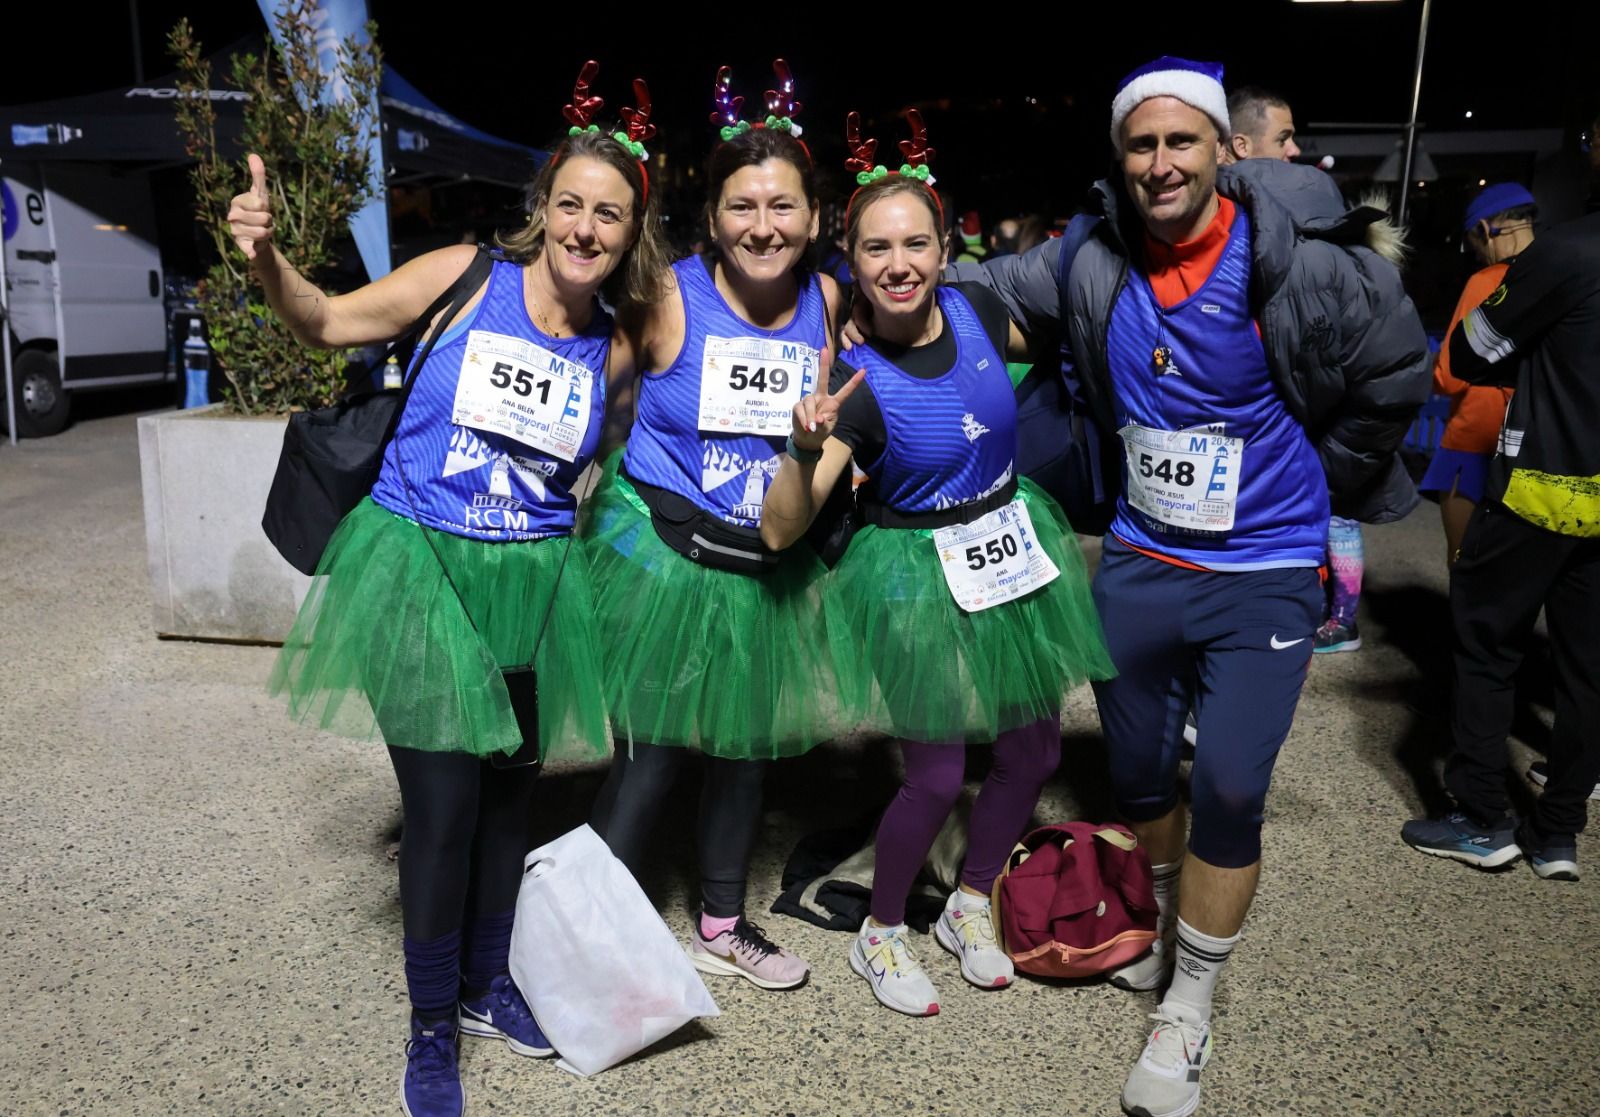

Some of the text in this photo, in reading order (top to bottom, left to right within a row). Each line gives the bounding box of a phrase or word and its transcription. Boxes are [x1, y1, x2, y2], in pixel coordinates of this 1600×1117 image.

[490, 361, 552, 405] 551
[729, 364, 789, 394] 549
[502, 398, 536, 415] ANA BELEN
[745, 399, 769, 407] AURORA
[509, 410, 550, 433] mayoral
[750, 409, 791, 419] mayoral
[1140, 453, 1195, 487] 548
[1156, 497, 1196, 512] mayoral
[1167, 490, 1185, 500] JESUS
[465, 505, 528, 531] RCM
[965, 533, 1018, 571] 550
[996, 568, 1008, 578] ANA
[998, 567, 1030, 587] mayoral
